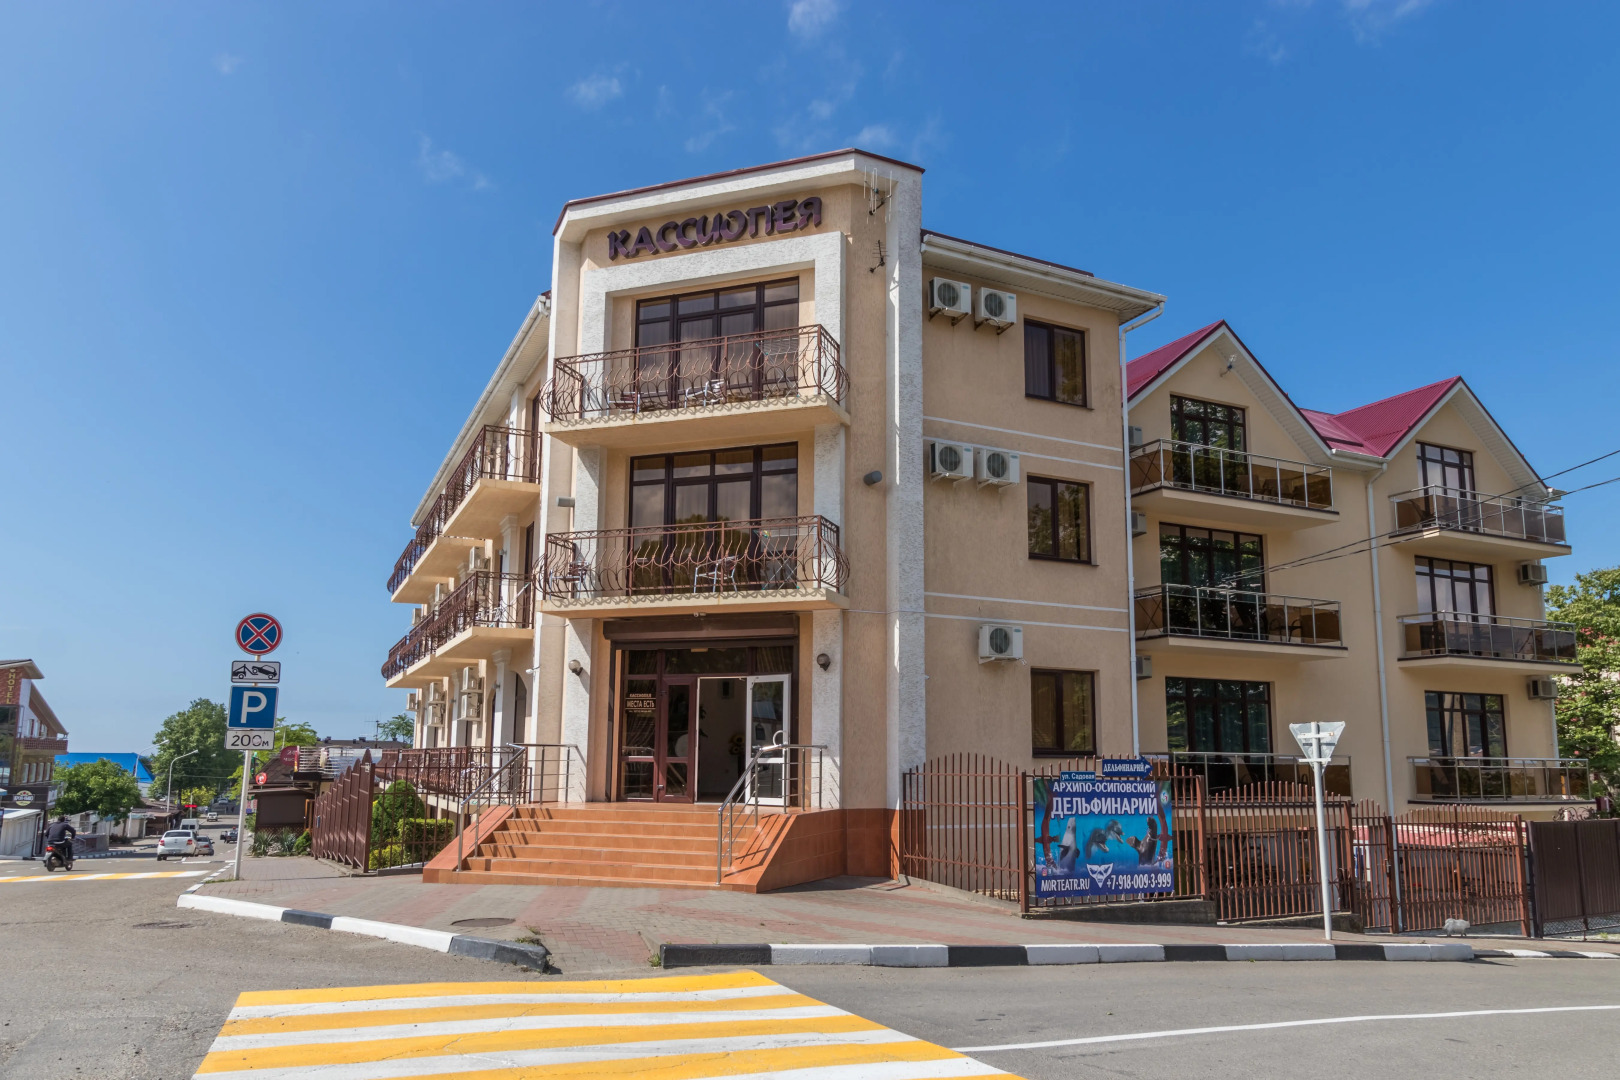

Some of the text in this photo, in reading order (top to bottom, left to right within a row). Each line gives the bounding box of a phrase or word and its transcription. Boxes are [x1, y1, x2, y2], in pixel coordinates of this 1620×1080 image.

[607, 197, 822, 260] КАССИОПЕЯ
[6, 672, 16, 704] HOTEL
[240, 691, 267, 724] P
[1103, 763, 1144, 772] ДЕЛЬФИНАРИЙ
[1053, 781, 1156, 793] АРХИПО-ОСИПОВСКИЙ
[1051, 794, 1158, 819] ДЕЛЬФИНАРИЙ
[1041, 878, 1090, 892] MORTEATR.RU
